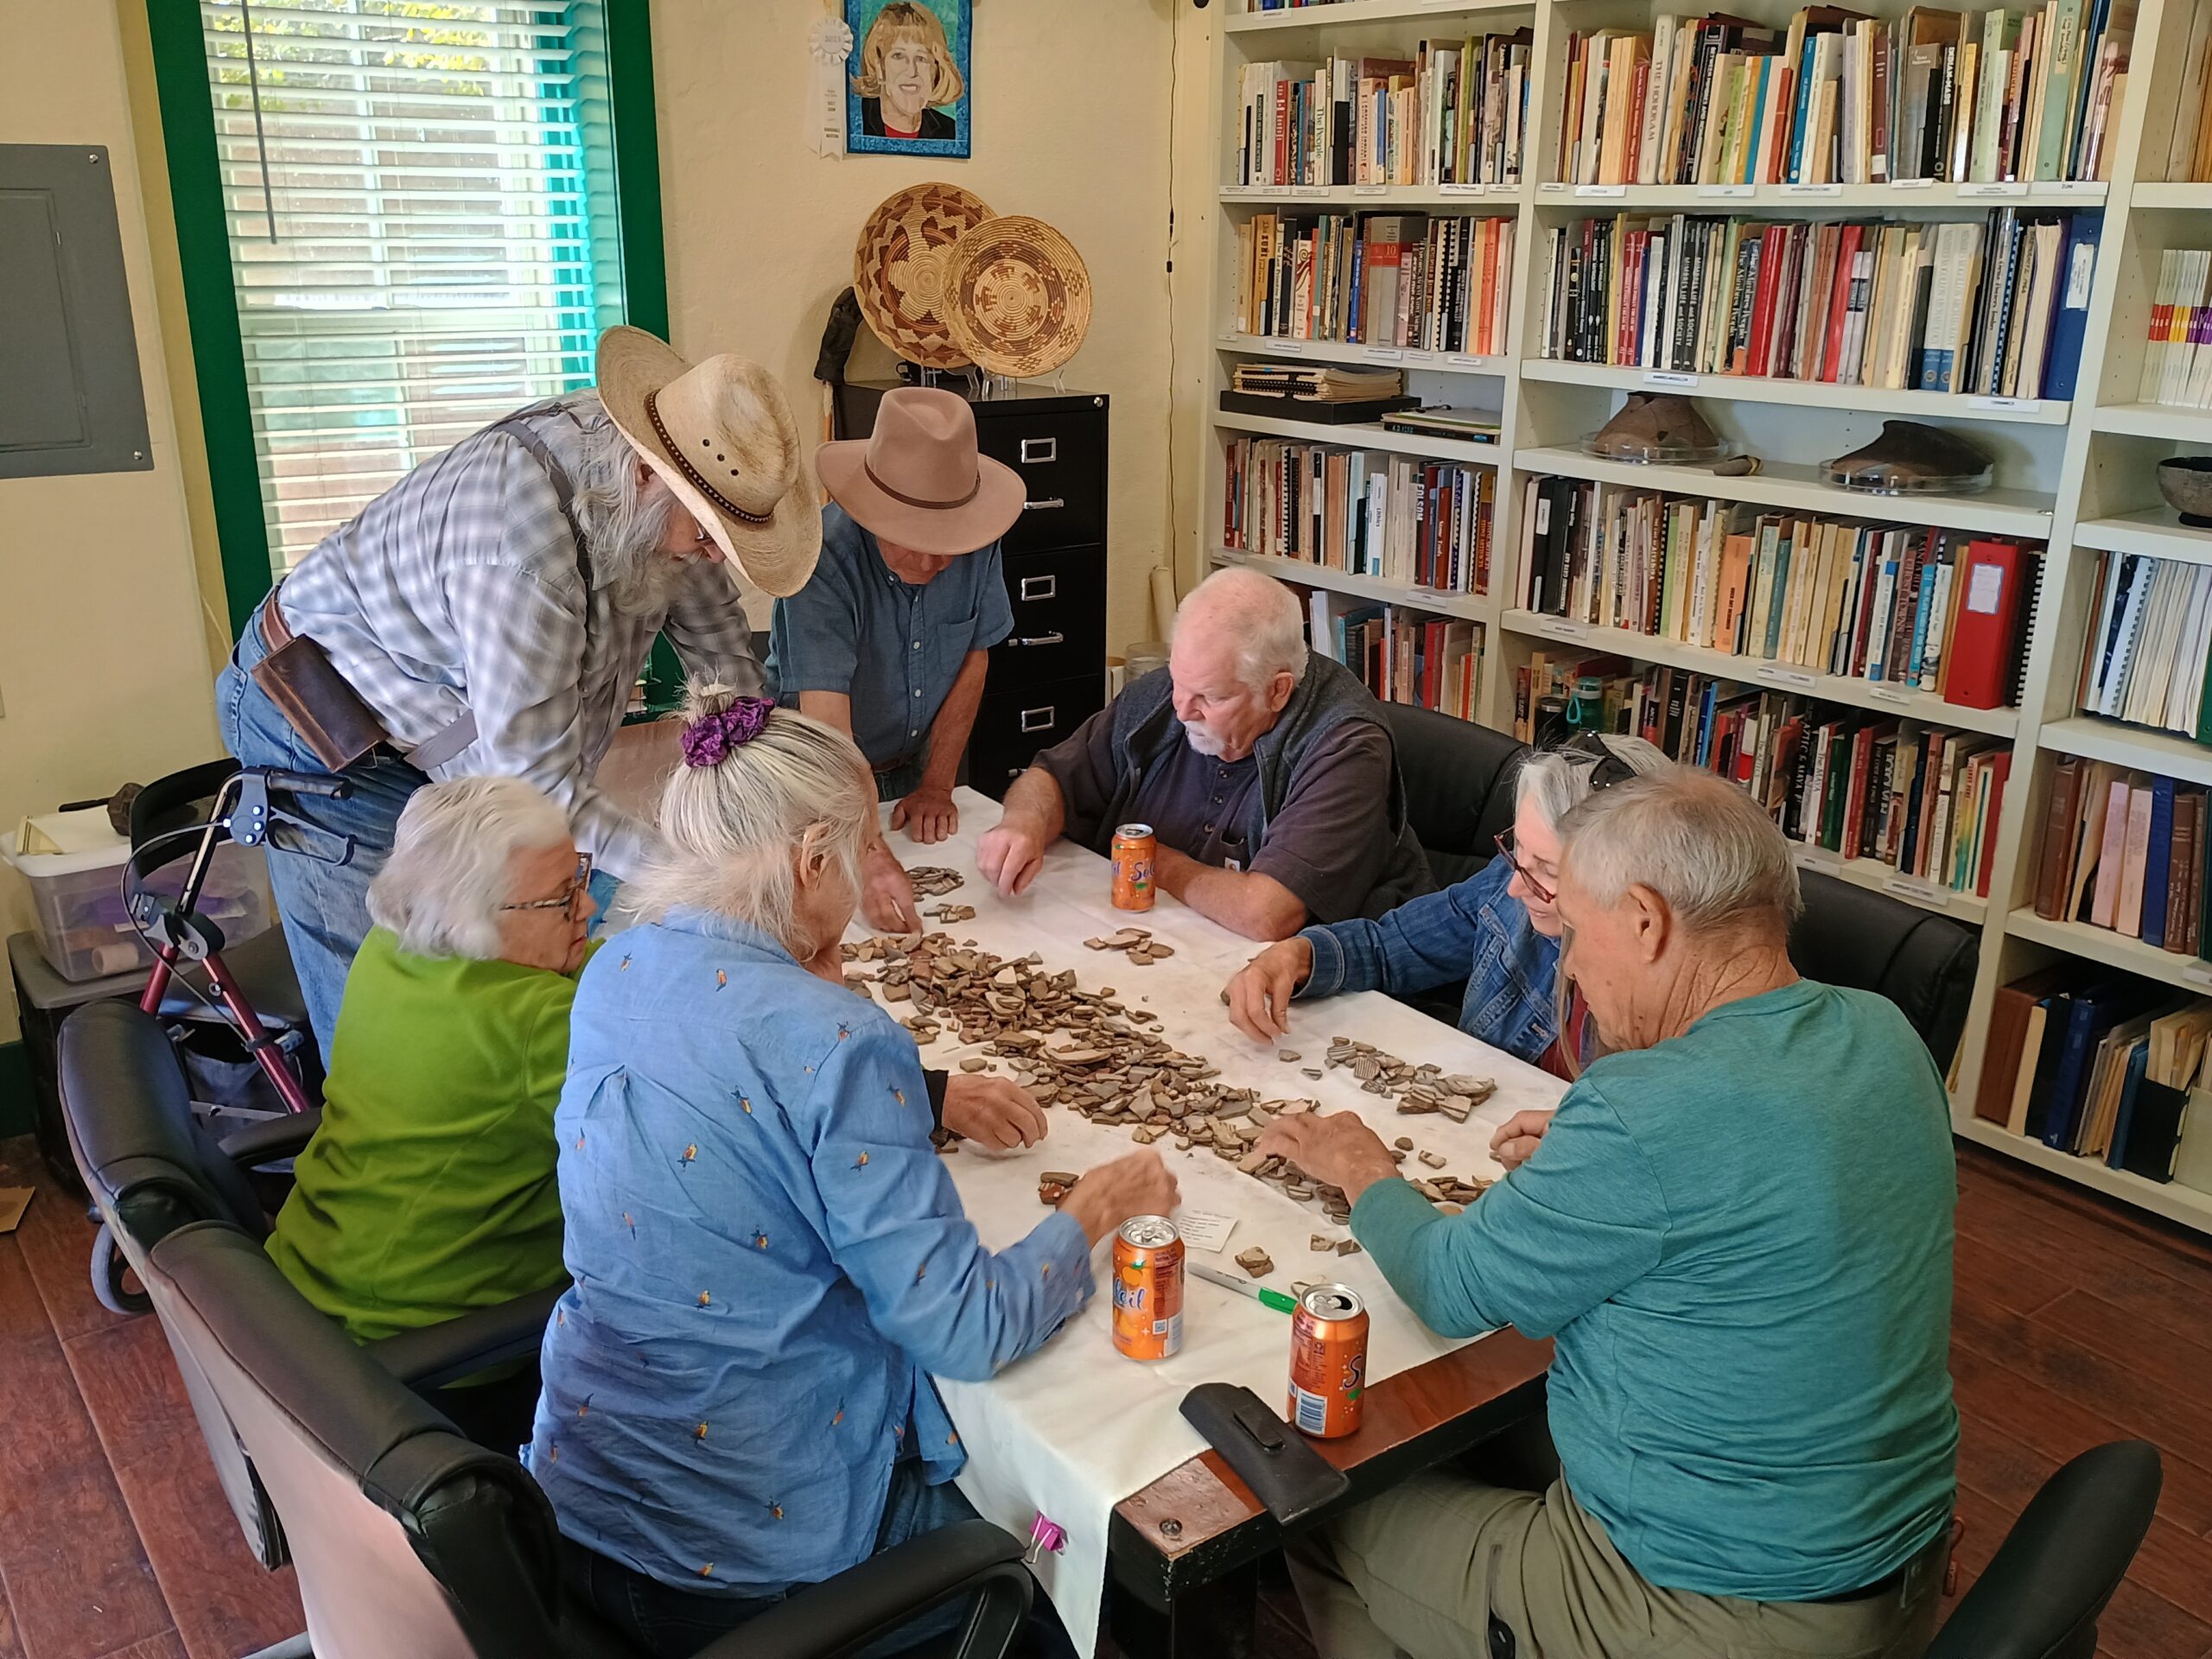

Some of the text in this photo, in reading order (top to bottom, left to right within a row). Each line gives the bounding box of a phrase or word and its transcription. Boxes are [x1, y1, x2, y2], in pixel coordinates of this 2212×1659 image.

[1700, 47, 1717, 119] BETWEEN MIMBRES AND
[1648, 85, 1662, 142] HOHOKAM
[1315, 127, 1324, 159] People
[1385, 245, 1397, 257] 10
[1681, 257, 1691, 289] MIMBRES
[1691, 257, 1701, 289] MIMBRES
[1744, 270, 1757, 308] Mimbres
[1680, 290, 1689, 304] LIFE
[1690, 290, 1700, 304] LIFE
[1729, 251, 1748, 336] The Mimbres People
[1675, 318, 1686, 346] SOCIETY
[1686, 318, 1695, 346] SOCIETY
[1738, 310, 1752, 338] People
[1416, 484, 1425, 521] FOLSOM
[1649, 546, 1657, 580] ALTAMIRA
[1916, 540, 1929, 572] SANTA
[1897, 558, 1913, 632] GHOST TOWNS
[1795, 764, 1805, 789] MAYA
[1814, 768, 1824, 793] MAYA
